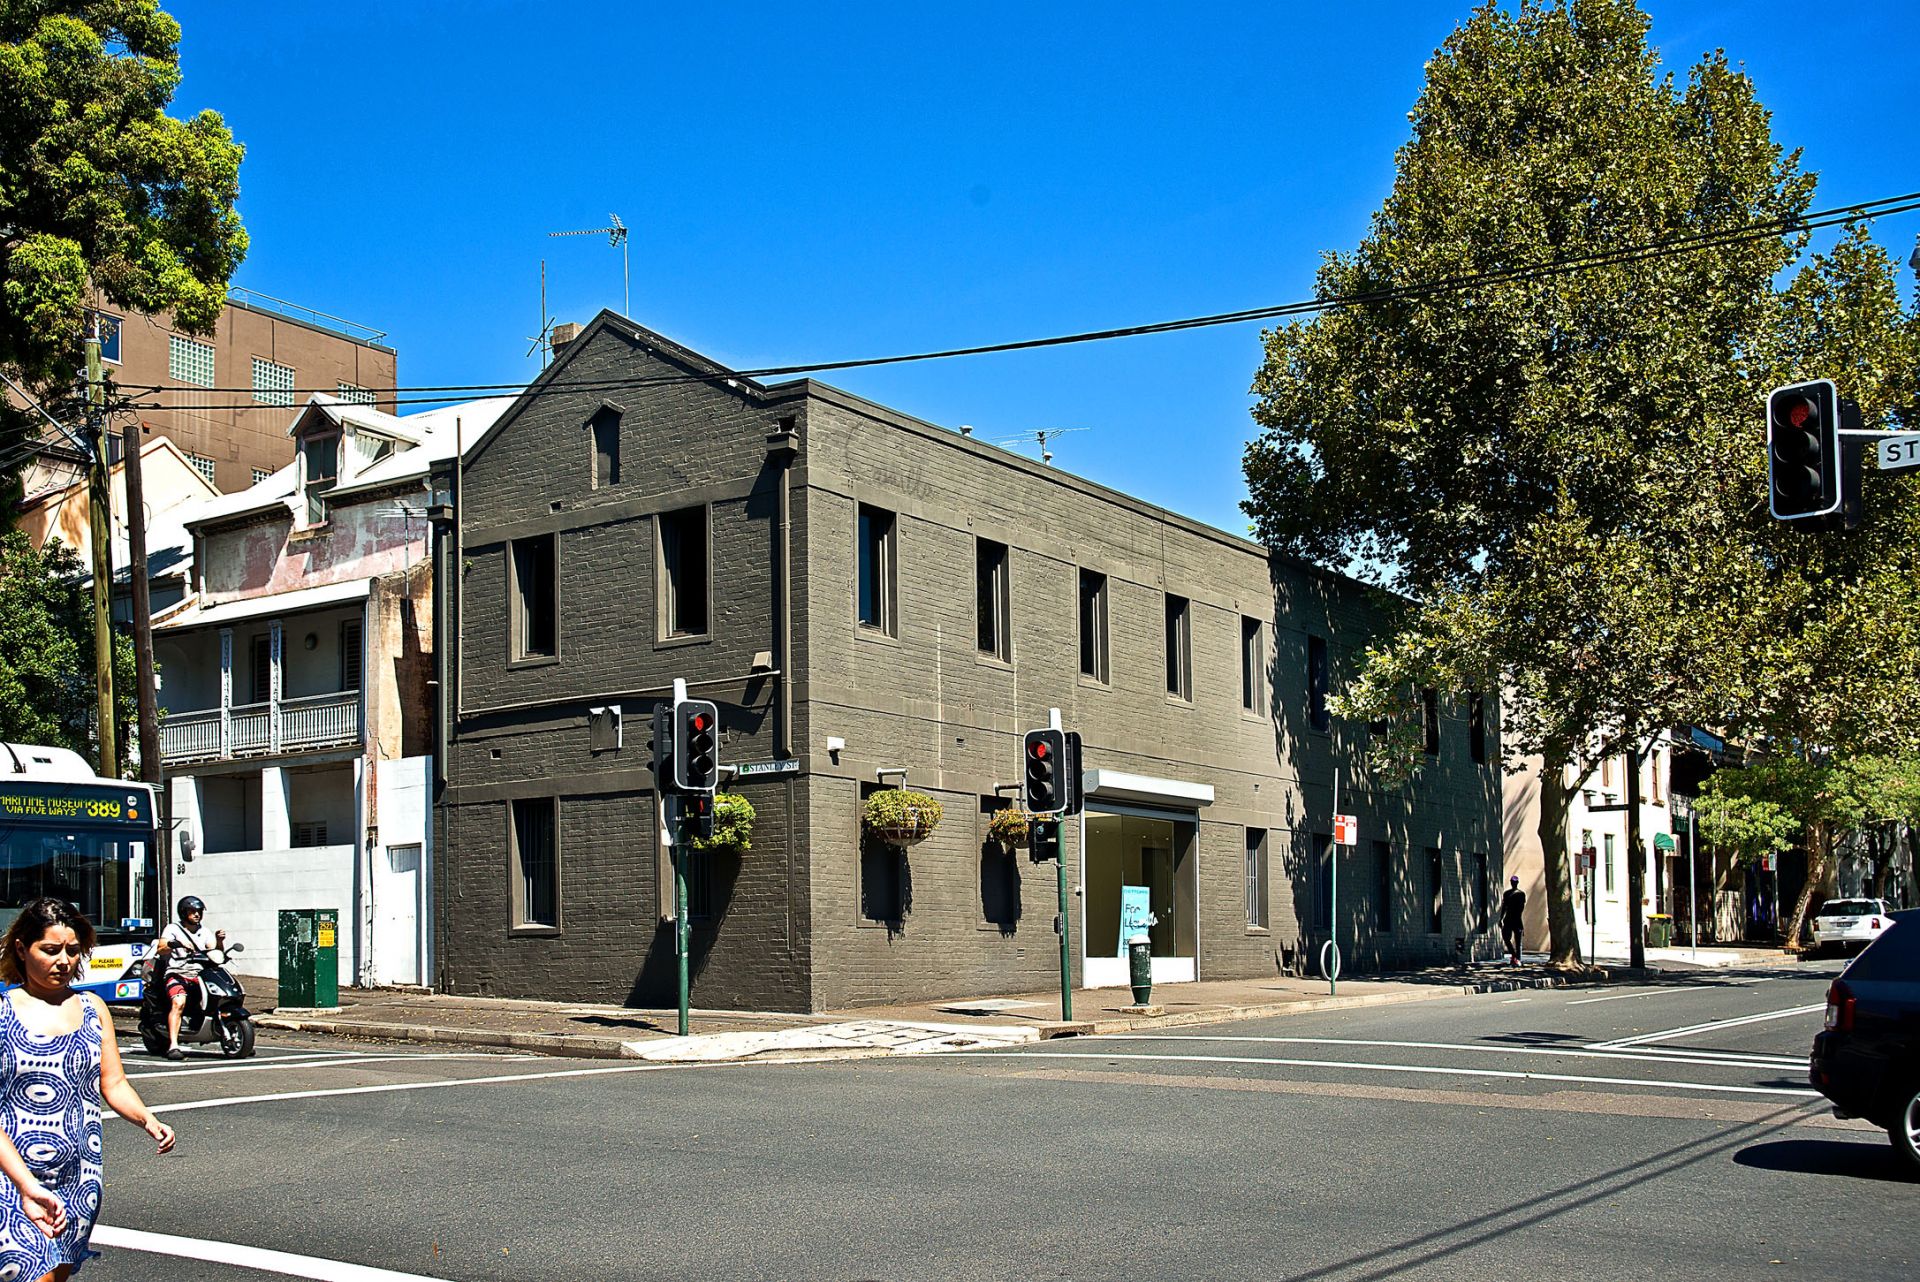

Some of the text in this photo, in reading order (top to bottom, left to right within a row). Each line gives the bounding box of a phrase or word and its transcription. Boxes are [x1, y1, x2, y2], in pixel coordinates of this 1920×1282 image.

[1886, 440, 1919, 462] ST
[750, 762, 785, 772] STANLEY
[47, 797, 88, 808] MUSEUM
[6, 805, 77, 816] VIA FIVE WAYS
[87, 801, 120, 817] 389
